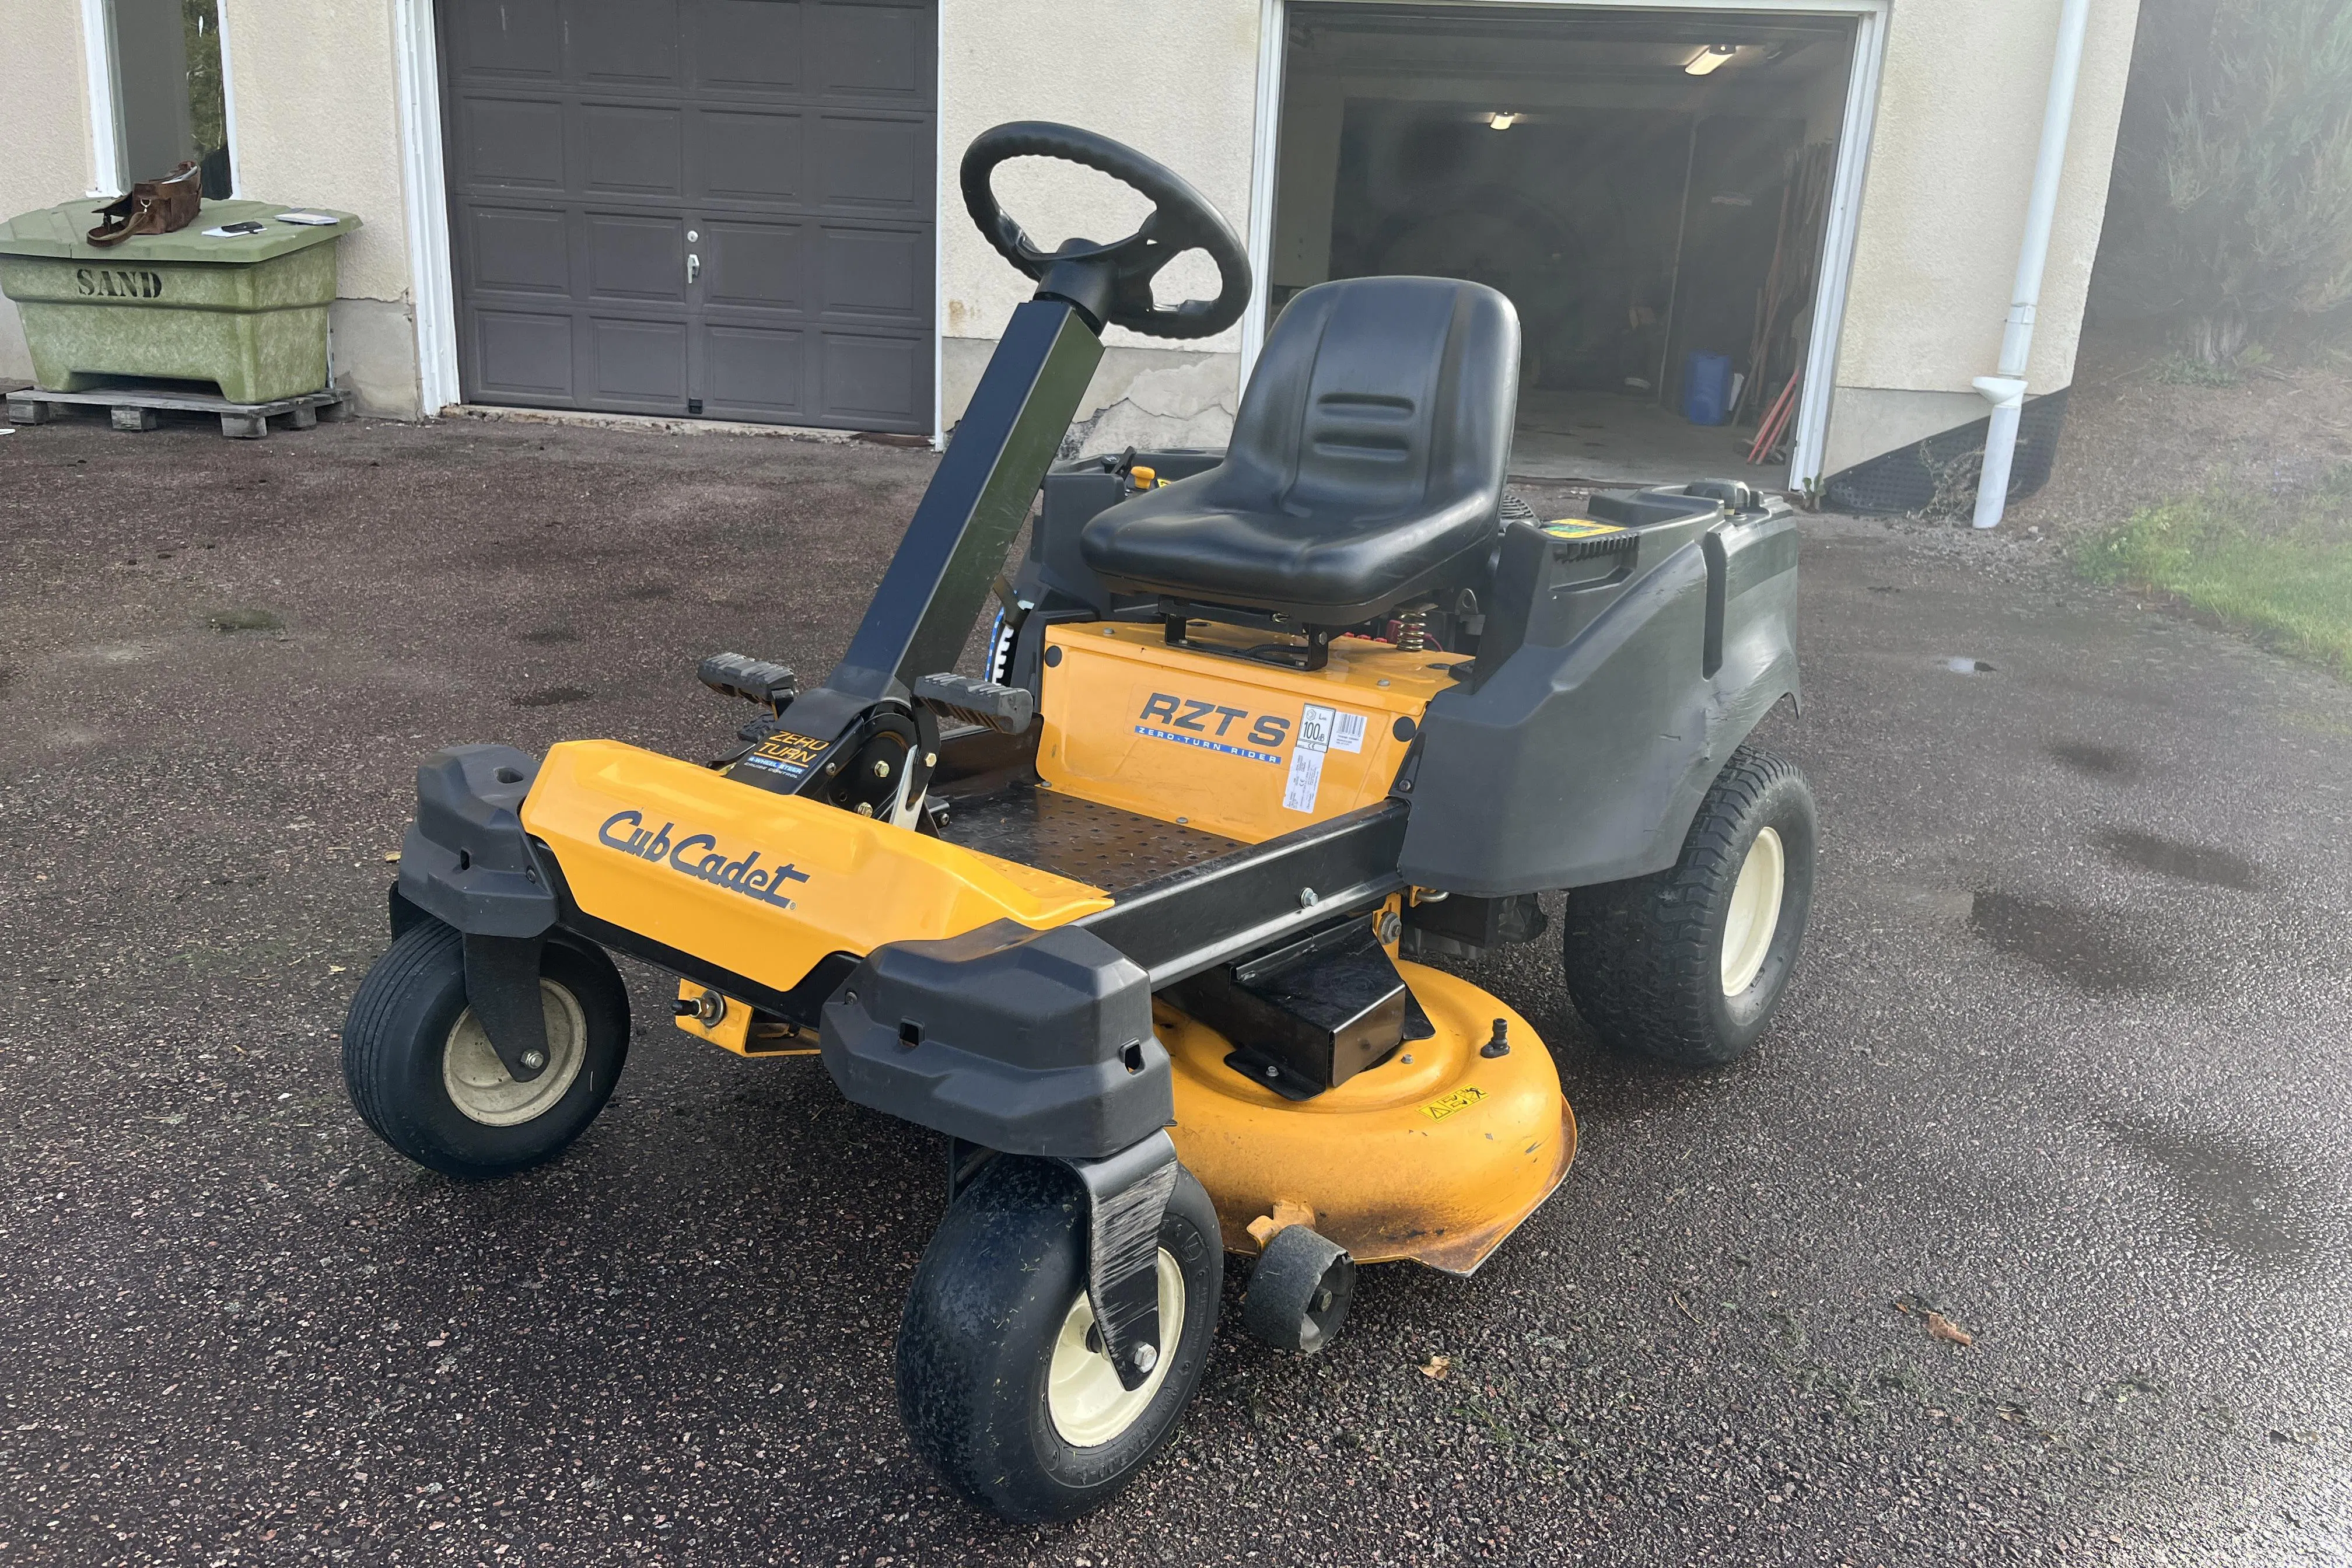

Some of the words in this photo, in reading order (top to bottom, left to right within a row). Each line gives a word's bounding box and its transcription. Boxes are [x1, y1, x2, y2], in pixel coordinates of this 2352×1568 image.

[76, 268, 162, 298] SAND
[1139, 692, 1248, 736] RZT
[1247, 715, 1291, 747] S
[768, 730, 830, 751] ZERO
[1303, 721, 1321, 741] 100
[758, 741, 817, 763] TURN
[1138, 727, 1221, 751] ZERO-TURN
[1230, 747, 1277, 763] RIDER
[748, 755, 777, 768] 4-WHEEL
[778, 761, 804, 775] STEER
[768, 767, 798, 779] CONTROL
[598, 810, 674, 863] Cub
[669, 834, 811, 909] Cadet
